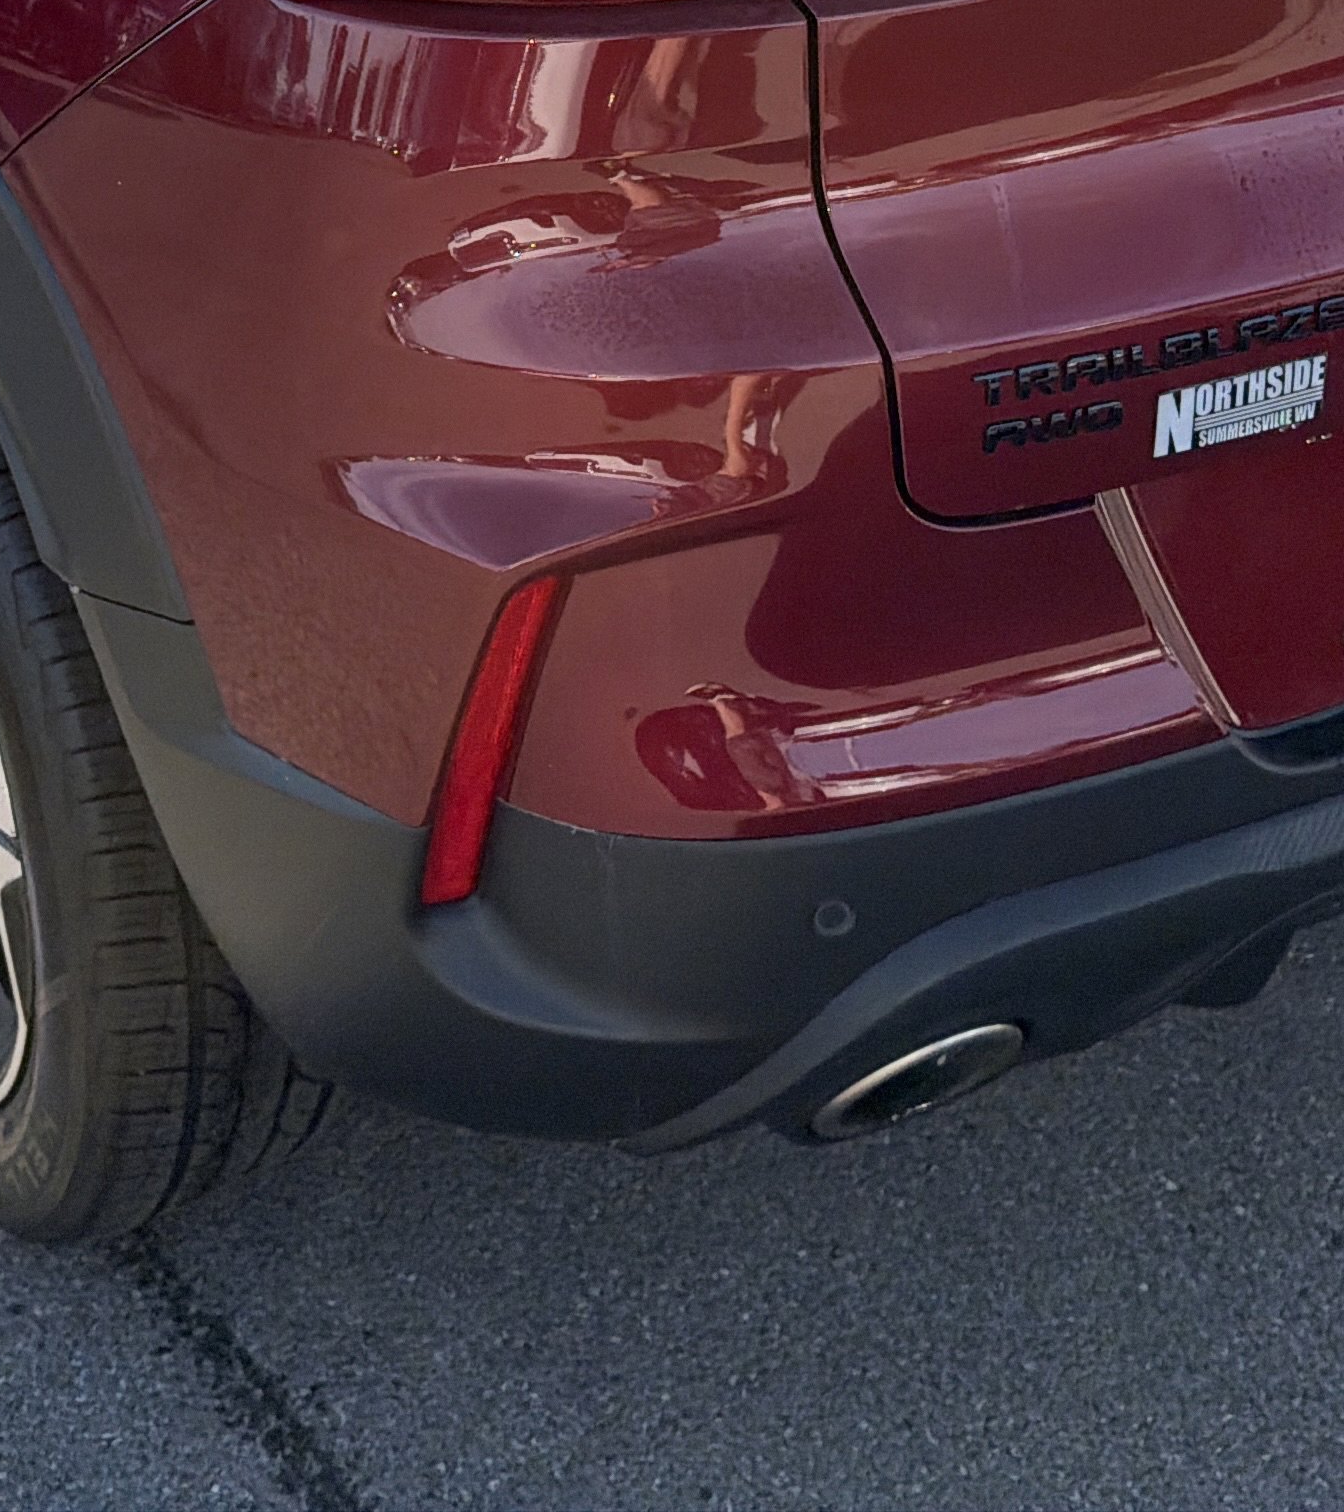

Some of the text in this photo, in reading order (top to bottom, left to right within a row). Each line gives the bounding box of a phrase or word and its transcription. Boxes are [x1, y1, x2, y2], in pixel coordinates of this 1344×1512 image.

[982, 399, 1124, 455] AWD
[1153, 354, 1327, 459] NORTHSIDE
[1198, 401, 1317, 448] SUMMERSVILLE WV
